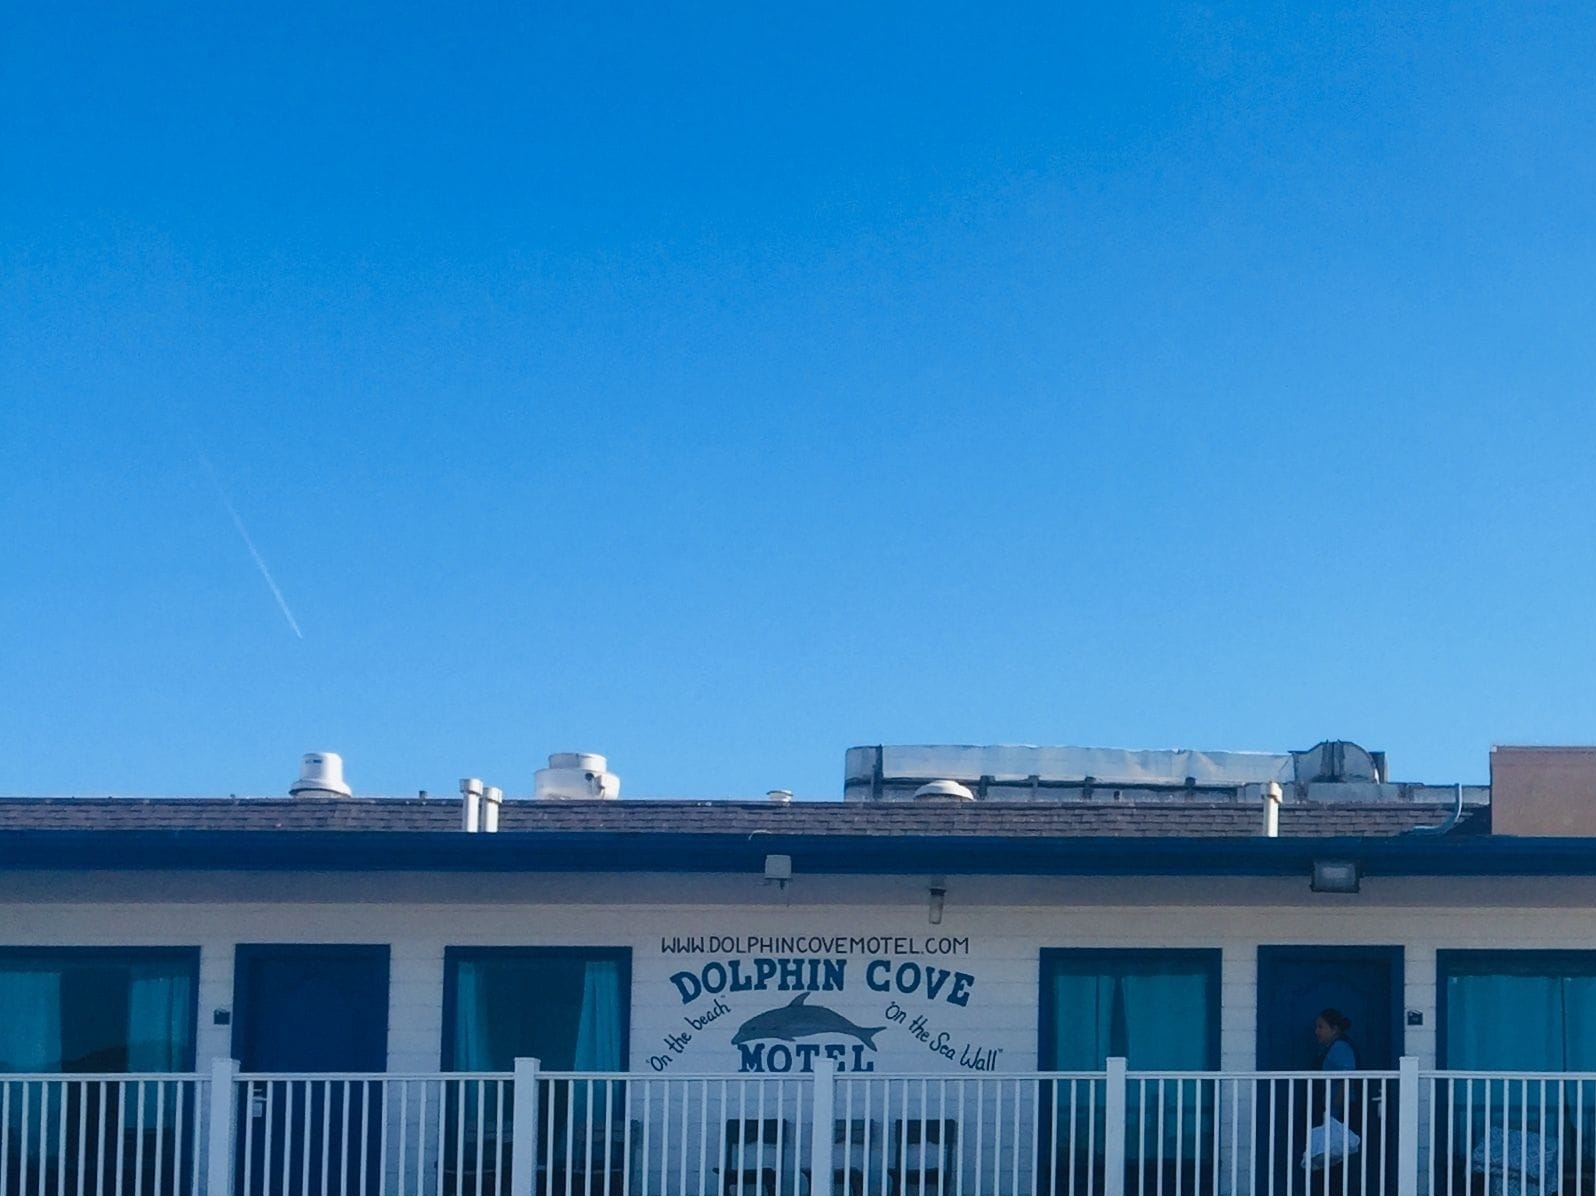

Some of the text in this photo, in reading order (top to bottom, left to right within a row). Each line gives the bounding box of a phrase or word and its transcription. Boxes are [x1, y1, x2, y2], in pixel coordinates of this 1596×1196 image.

[661, 936, 969, 955] WWW.DOLPHINCOVEMOTEL.COM
[669, 957, 975, 1007] DOLPHIN COVE
[663, 1032, 692, 1053] the
[908, 1014, 930, 1042] the
[929, 1031, 956, 1060] Sea
[737, 1043, 874, 1073] MOTEL
